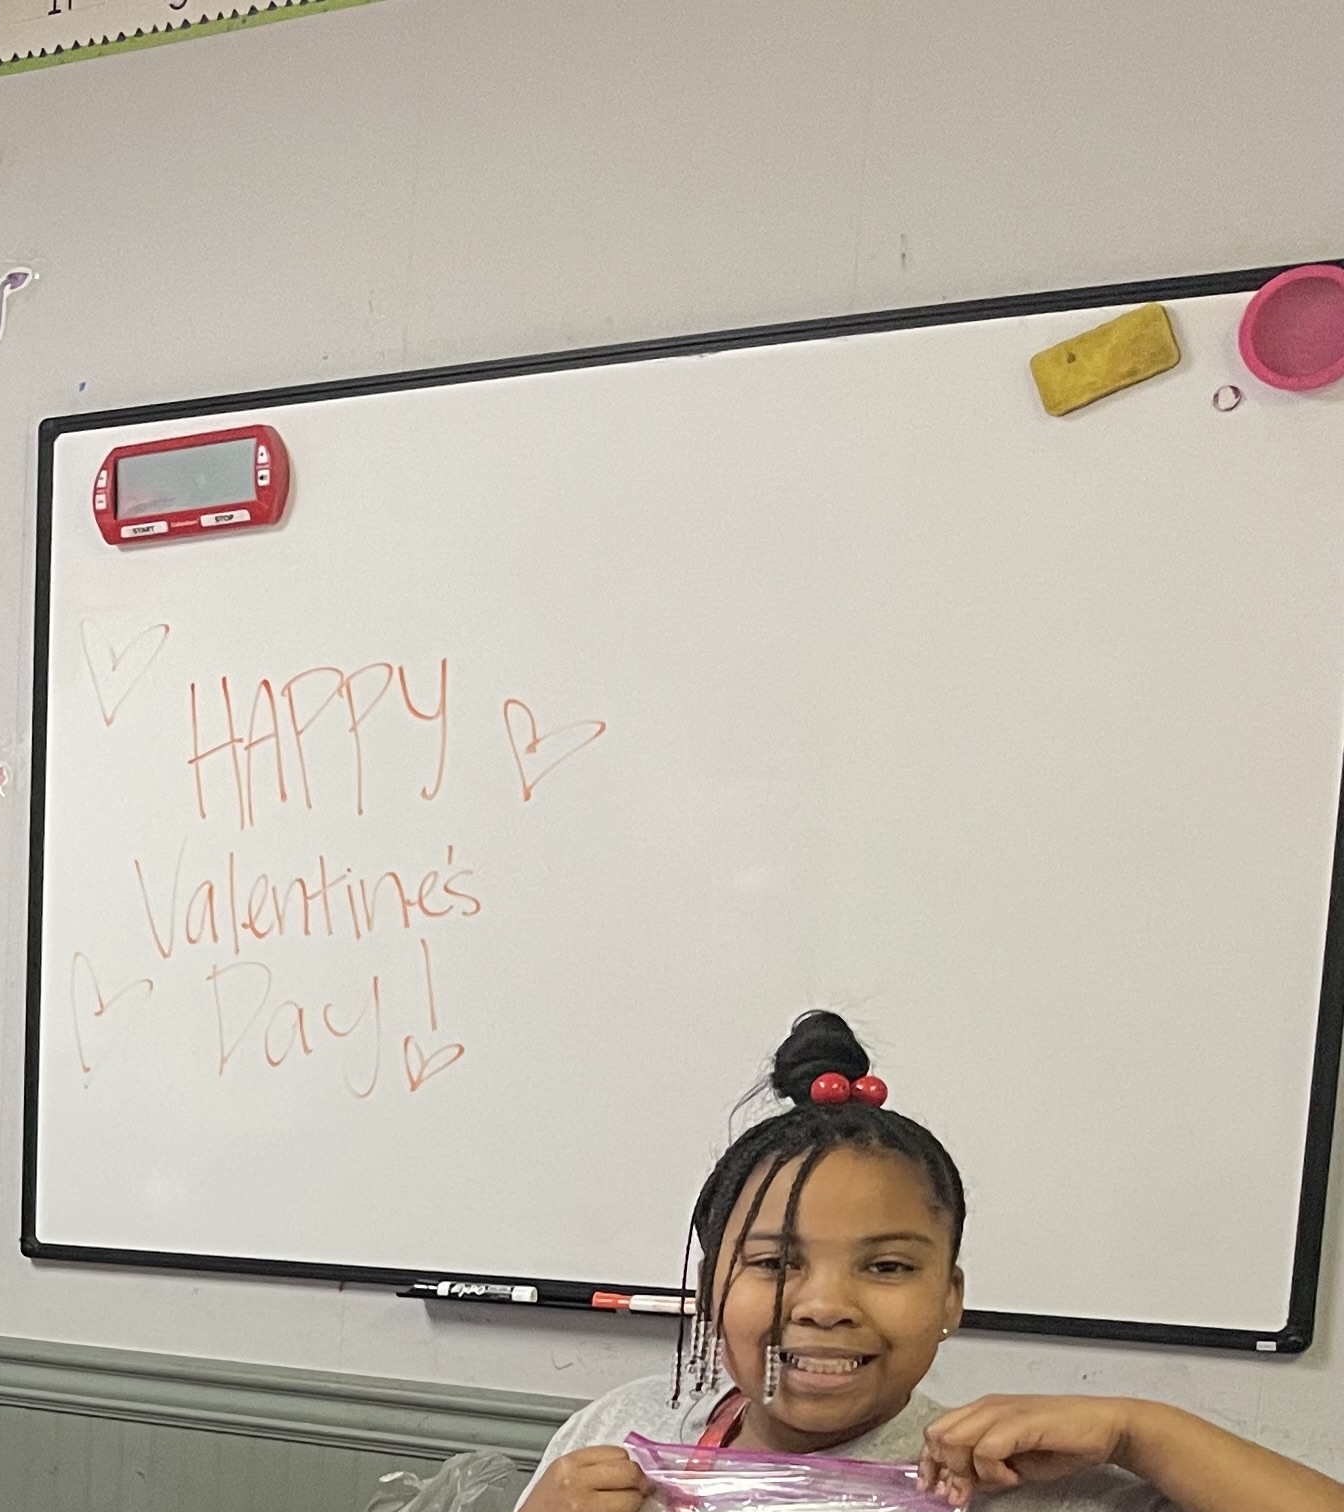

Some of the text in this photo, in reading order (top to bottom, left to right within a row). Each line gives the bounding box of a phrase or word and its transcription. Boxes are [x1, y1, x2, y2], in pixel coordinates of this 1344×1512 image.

[215, 514, 234, 523] STOP
[188, 657, 448, 830] HAPPY
[135, 835, 481, 958] Valentine's
